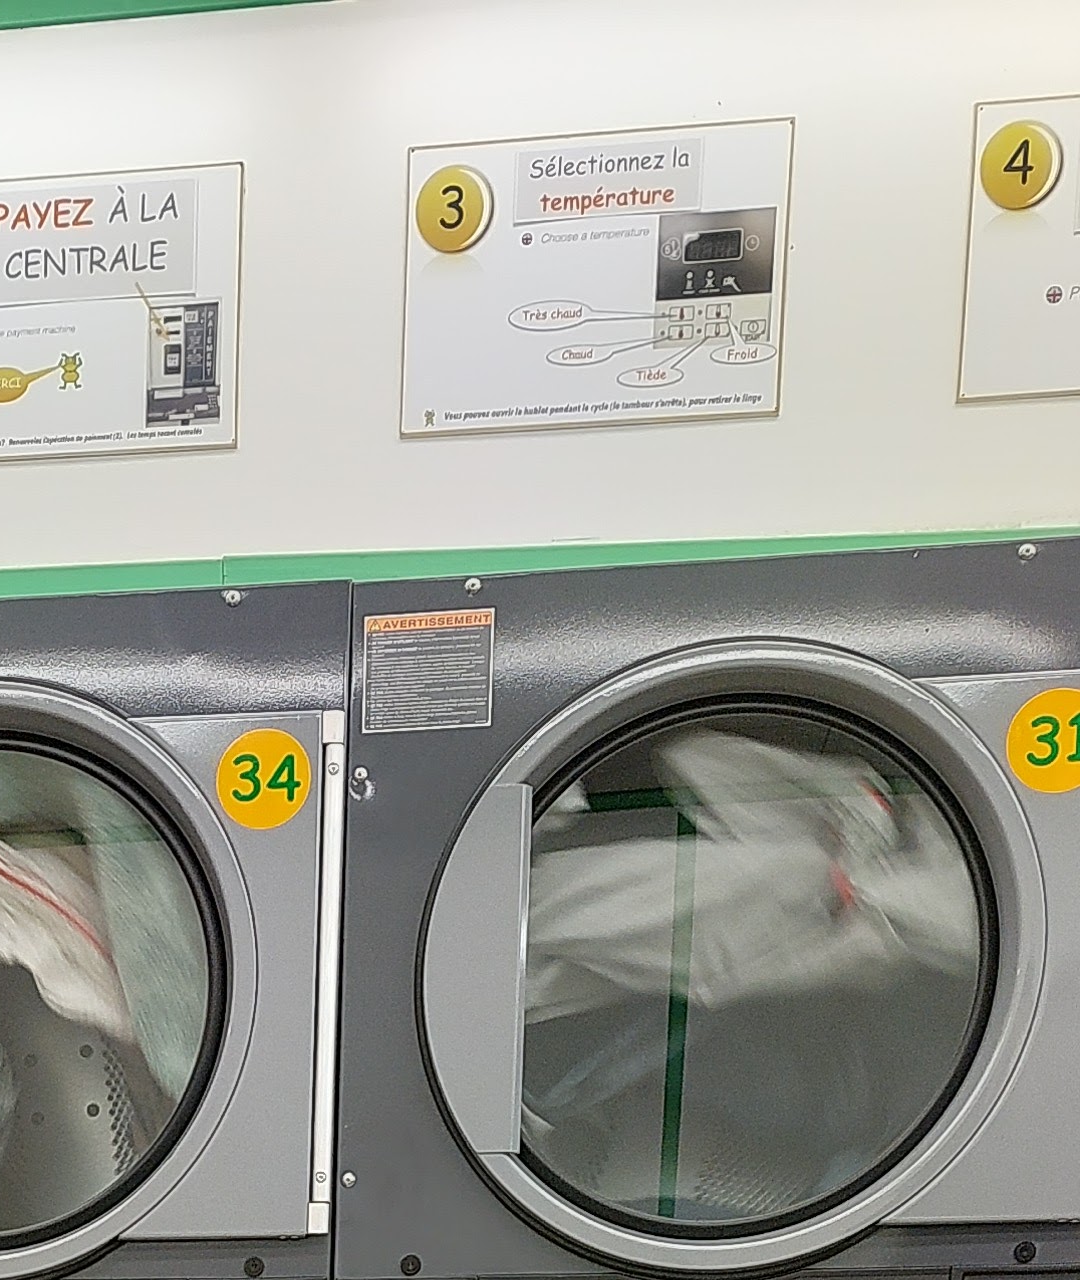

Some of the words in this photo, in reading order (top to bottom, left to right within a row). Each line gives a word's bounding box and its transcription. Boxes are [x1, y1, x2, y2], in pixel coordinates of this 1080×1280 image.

[529, 152, 665, 179] Sélectionnez
[671, 146, 689, 168] la
[1003, 138, 1035, 186] 4
[108, 185, 128, 224] À
[140, 192, 179, 222] LA
[439, 185, 464, 229] 3
[539, 186, 675, 215] température
[540, 232, 579, 244] Choose
[589, 228, 650, 240] temperature
[5, 239, 168, 280] CENTRALE
[522, 308, 548, 321] Très
[551, 307, 582, 320] chaud
[561, 348, 593, 361] Chaud
[727, 348, 758, 361] Froid
[636, 369, 666, 381] Tiède
[383, 614, 491, 630] AVERTISSEMENT
[232, 753, 301, 803] 34
